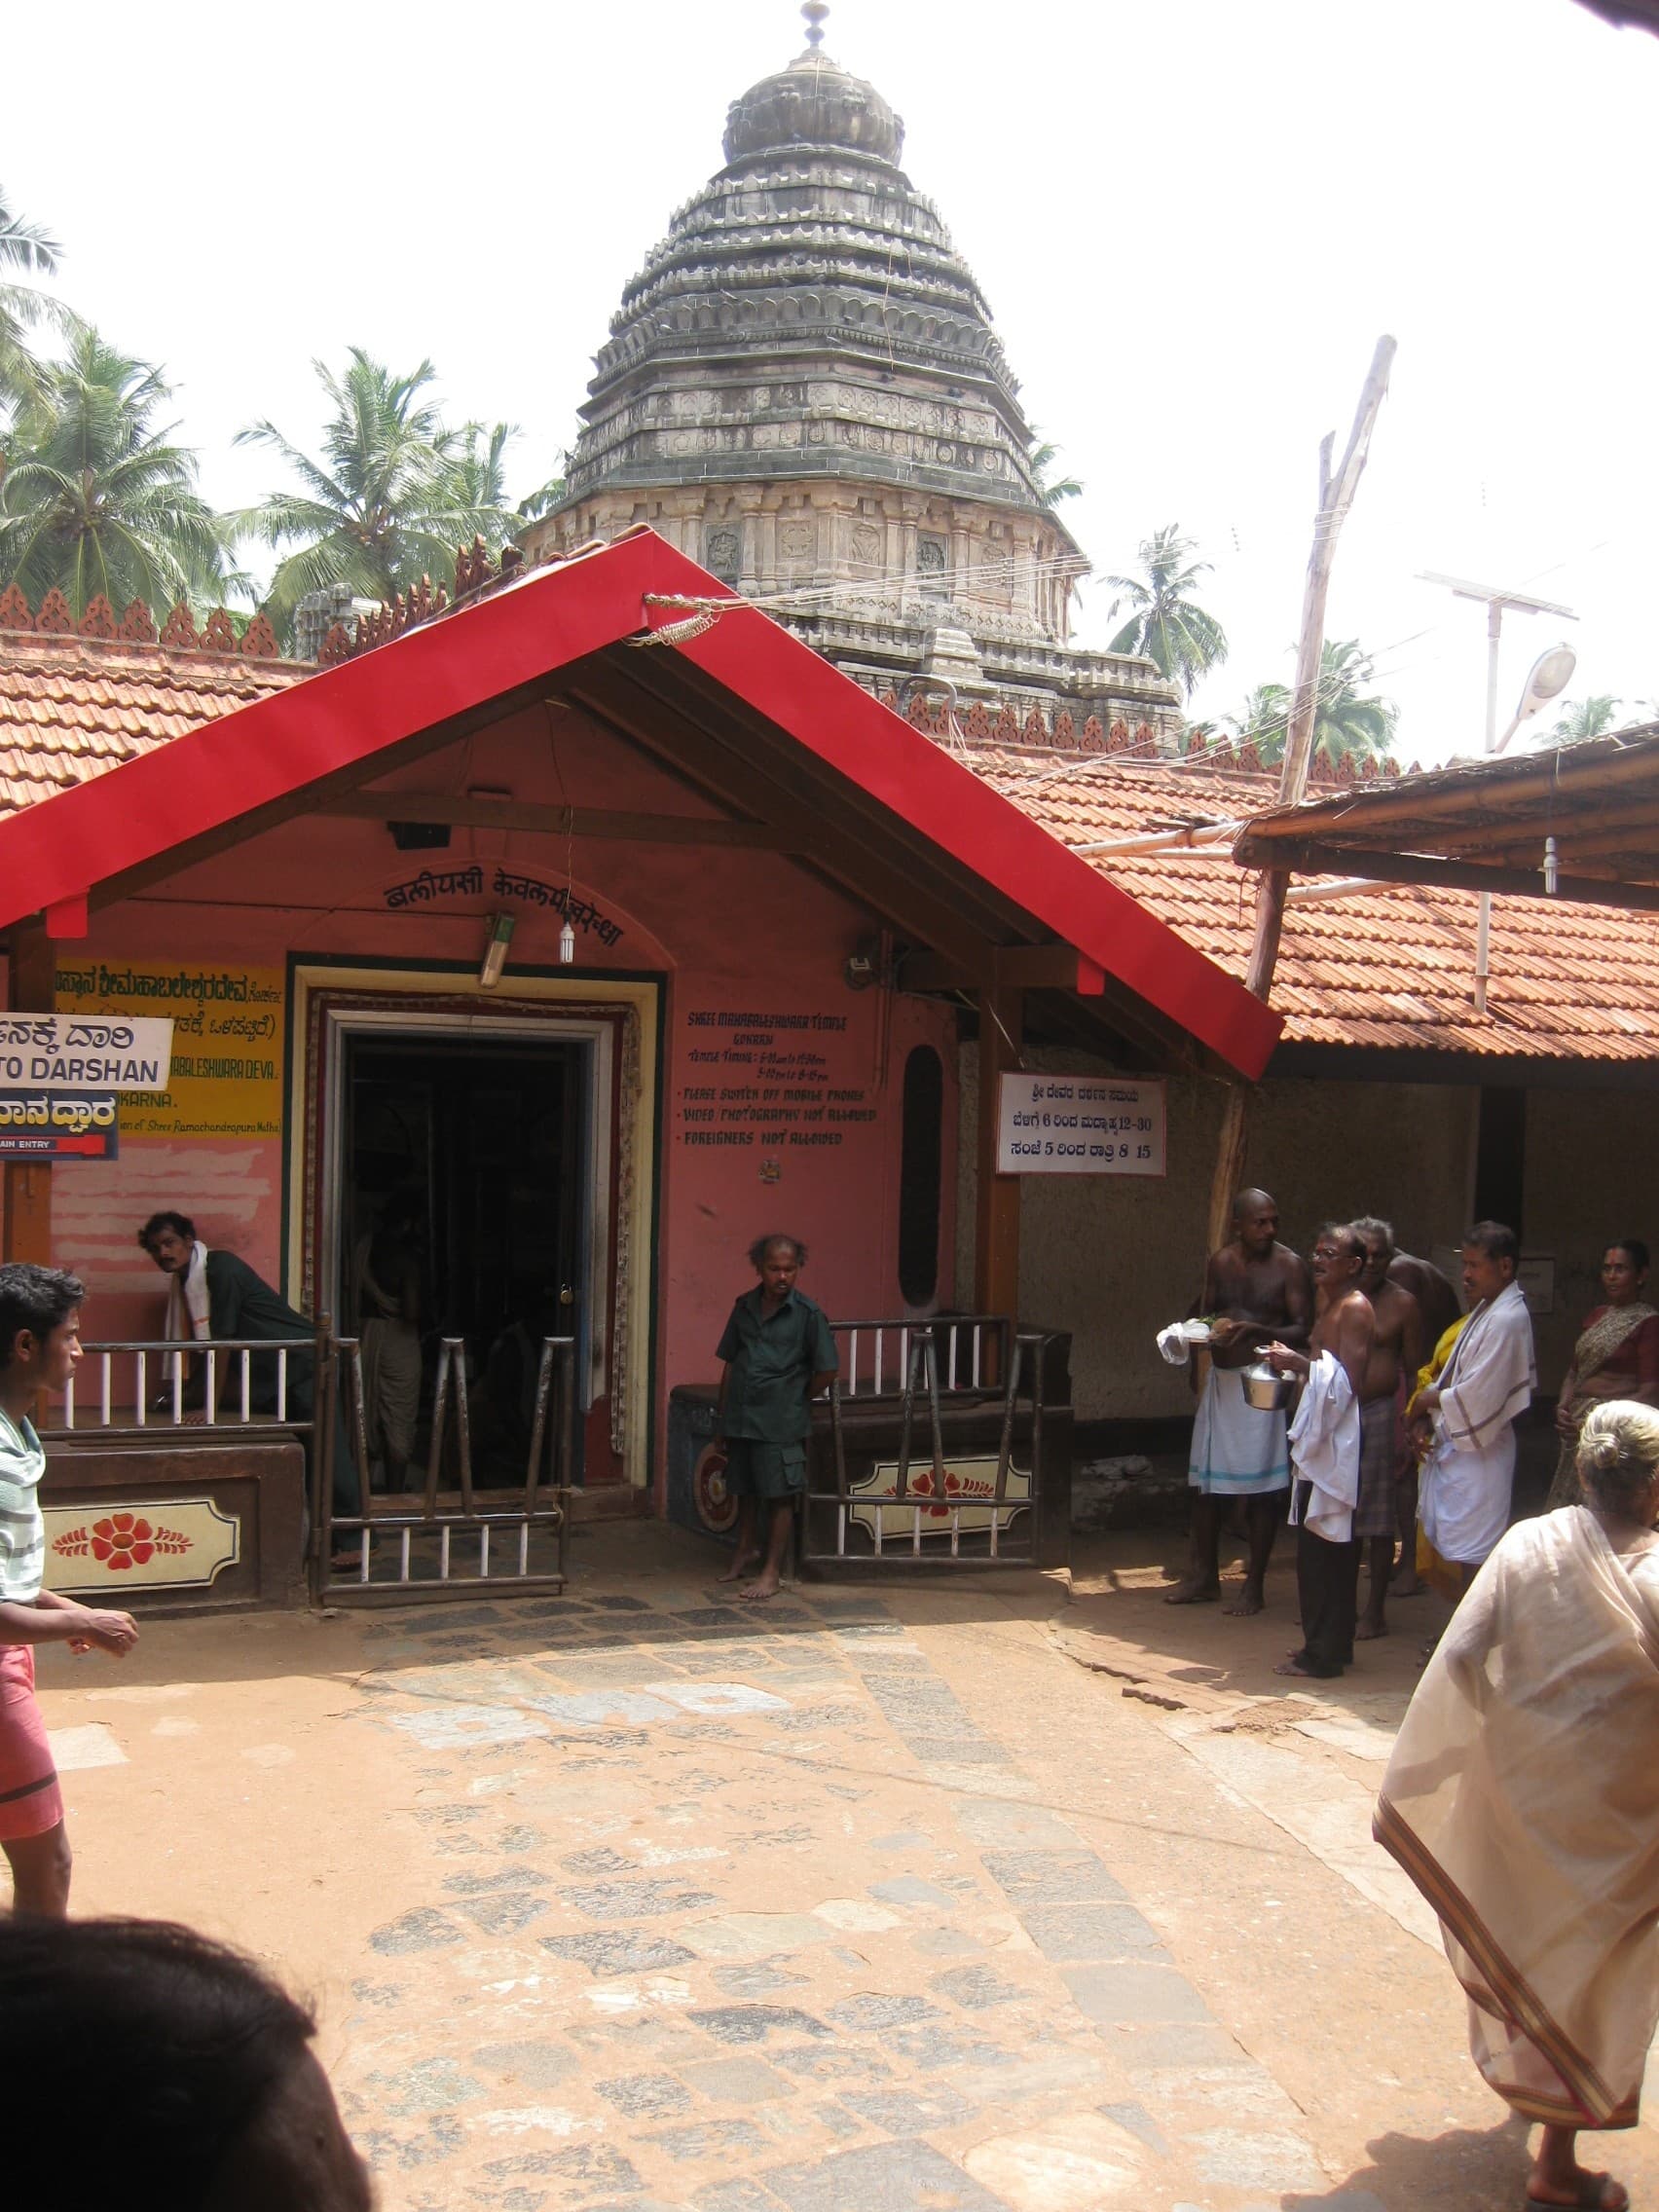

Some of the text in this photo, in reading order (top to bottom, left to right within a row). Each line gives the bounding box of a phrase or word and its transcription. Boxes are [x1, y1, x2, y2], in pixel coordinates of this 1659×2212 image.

[686, 1012, 717, 1026] SHREE
[811, 1013, 848, 1031] TEMPLE
[65, 1023, 134, 1050] ದಾರಿ
[687, 1049, 719, 1062] TEMPLE
[31, 1057, 158, 1083] DARSHAN
[683, 1088, 717, 1100] PLEASE
[719, 1086, 758, 1100] SWITCH
[762, 1088, 780, 1100] OFF
[783, 1088, 823, 1101] MOBILE
[1047, 1083, 1074, 1099] ದೇವರ
[683, 1107, 715, 1122] VIDEO
[803, 1106, 826, 1122] NOT
[827, 1108, 877, 1123] ALLOWED
[1043, 1113, 1051, 1127] 6
[18, 1140, 51, 1149] ENTRY
[684, 1128, 843, 1146] FOREIGNERS NOT ALLOWED
[1011, 1139, 1041, 1156] ಸಂಜೆ
[1045, 1141, 1053, 1156] 5
[1119, 1144, 1128, 1158] 8
[1136, 1145, 1151, 1159] 15
